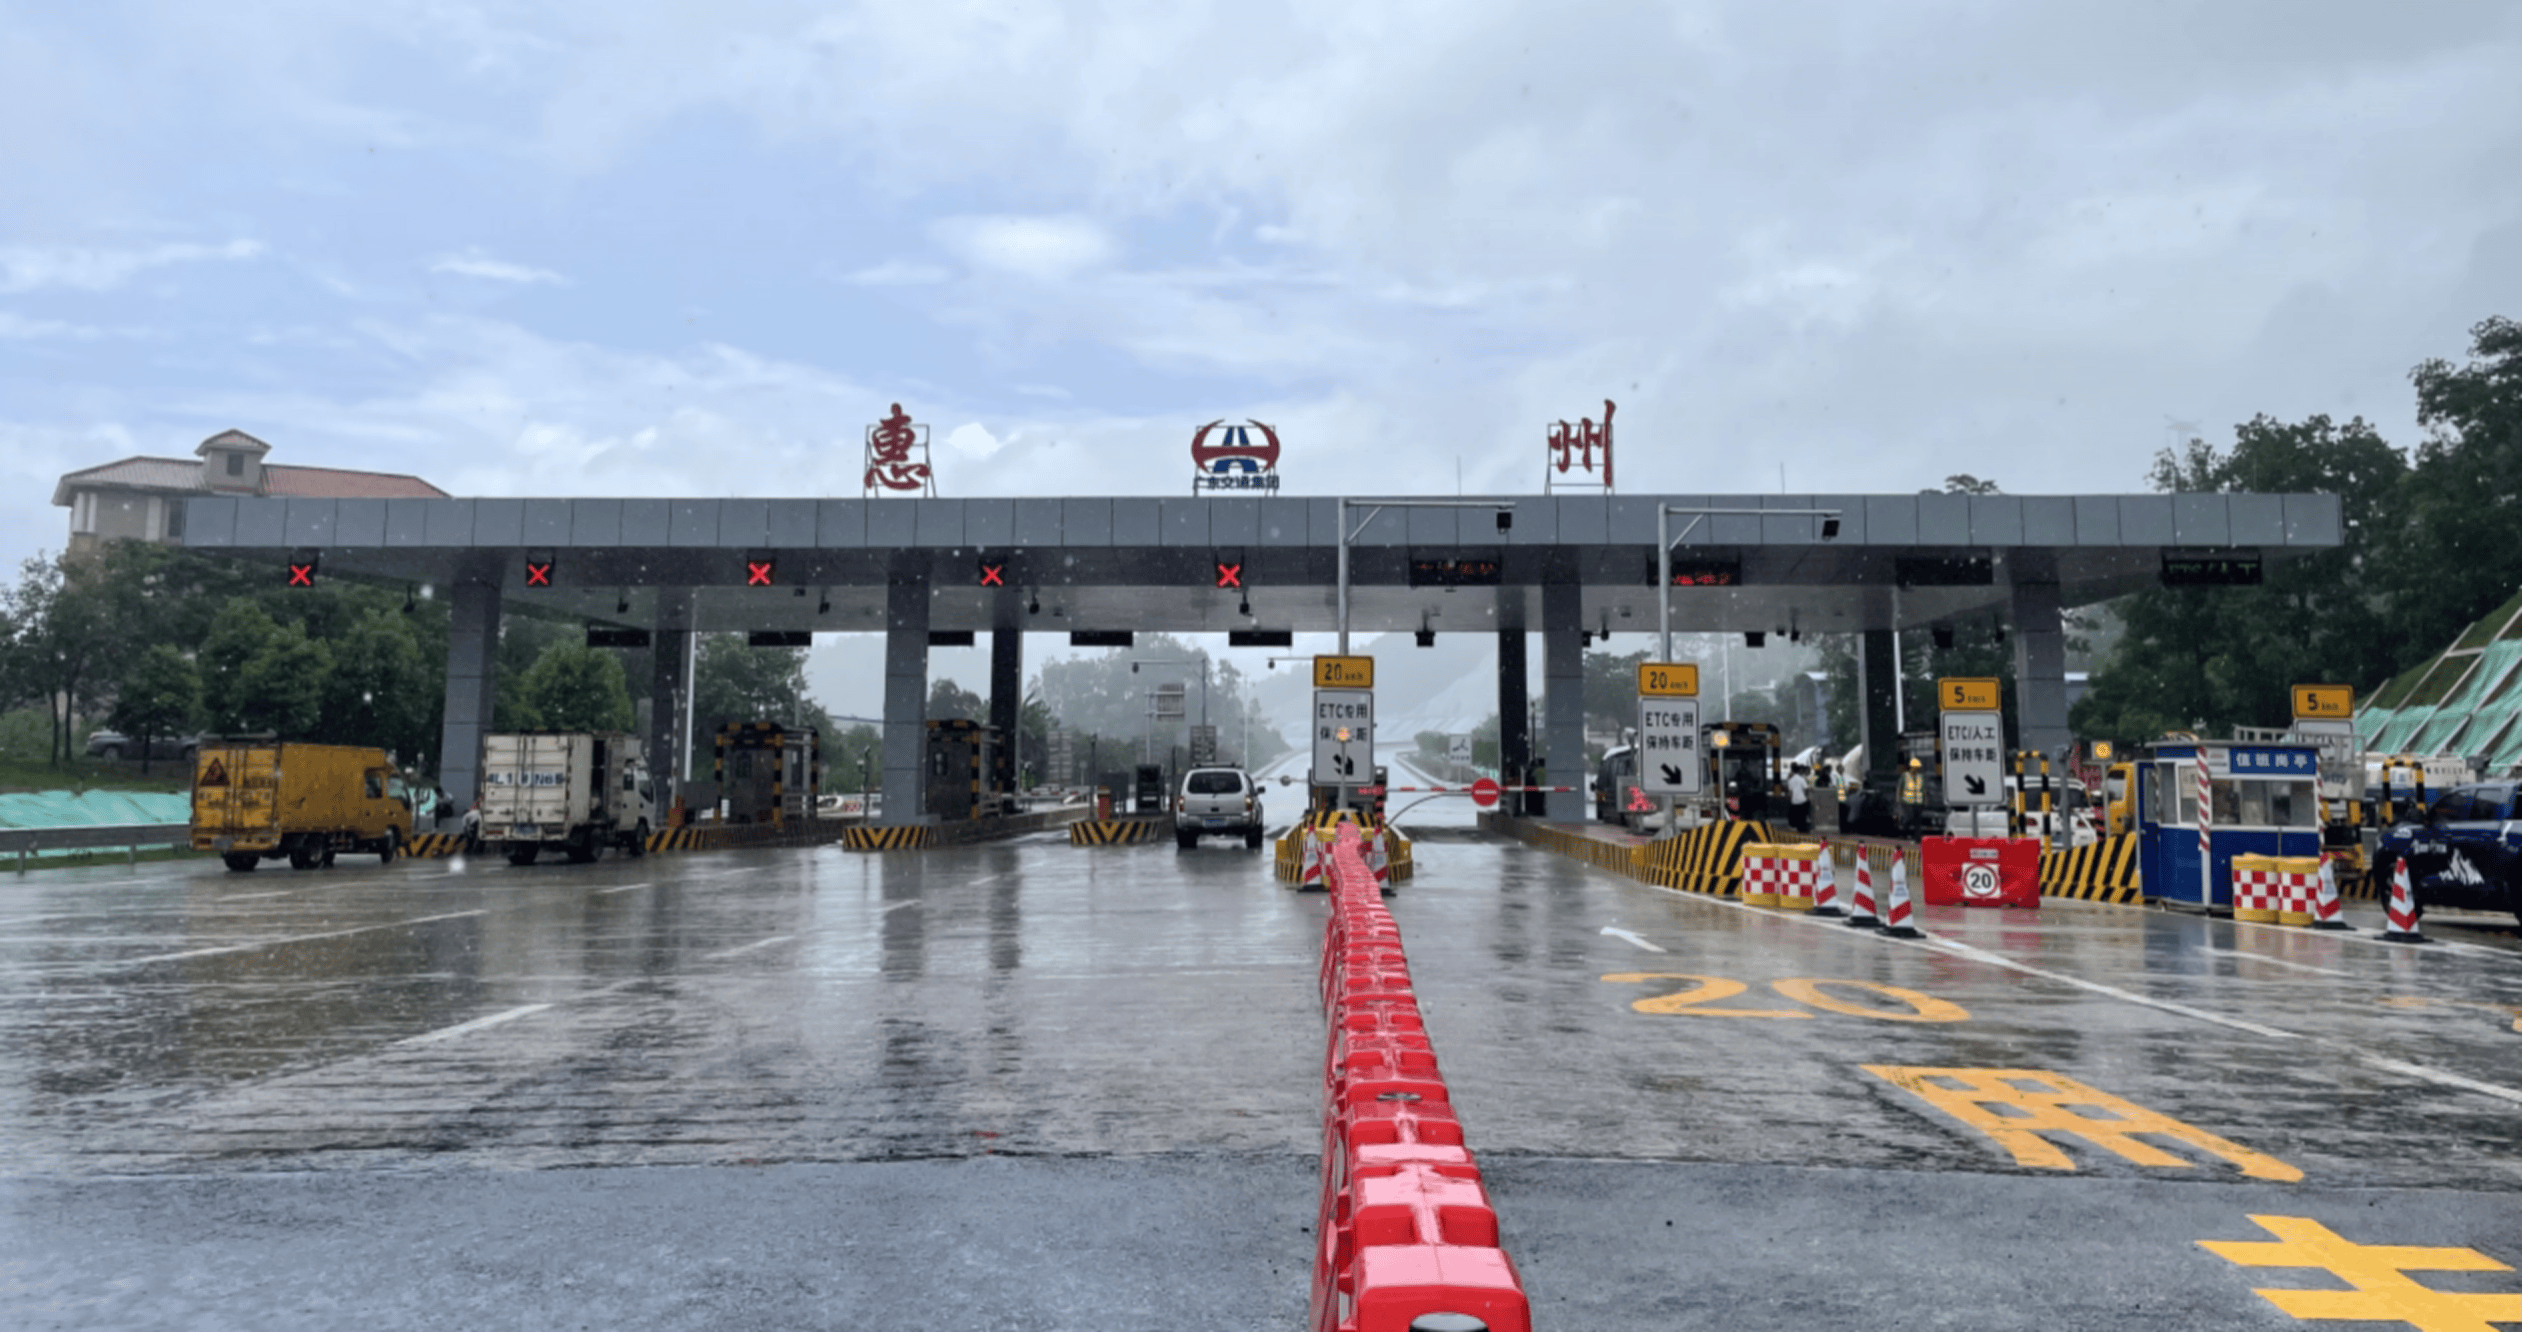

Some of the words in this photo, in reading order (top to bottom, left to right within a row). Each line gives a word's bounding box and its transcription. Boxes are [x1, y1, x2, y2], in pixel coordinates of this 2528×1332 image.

[865, 402, 930, 491] 惠
[1548, 398, 1617, 488] 州
[1193, 475, 1279, 490] 广东交通集团
[1324, 662, 1341, 681] 20
[1649, 671, 1668, 690] 20
[1953, 685, 1966, 704] 5
[2307, 692, 2318, 711] 5
[1319, 703, 1368, 718] ETC专用
[1645, 711, 1694, 727] ETC专用
[1320, 726, 1368, 742] 保距
[1947, 725, 1996, 740] ETC/人工
[1646, 735, 1694, 750] 保持车距
[1950, 747, 1997, 762] 保持车距
[1969, 872, 1992, 889] 20
[1601, 971, 1971, 1023] 20
[1858, 1064, 2304, 1182] 用
